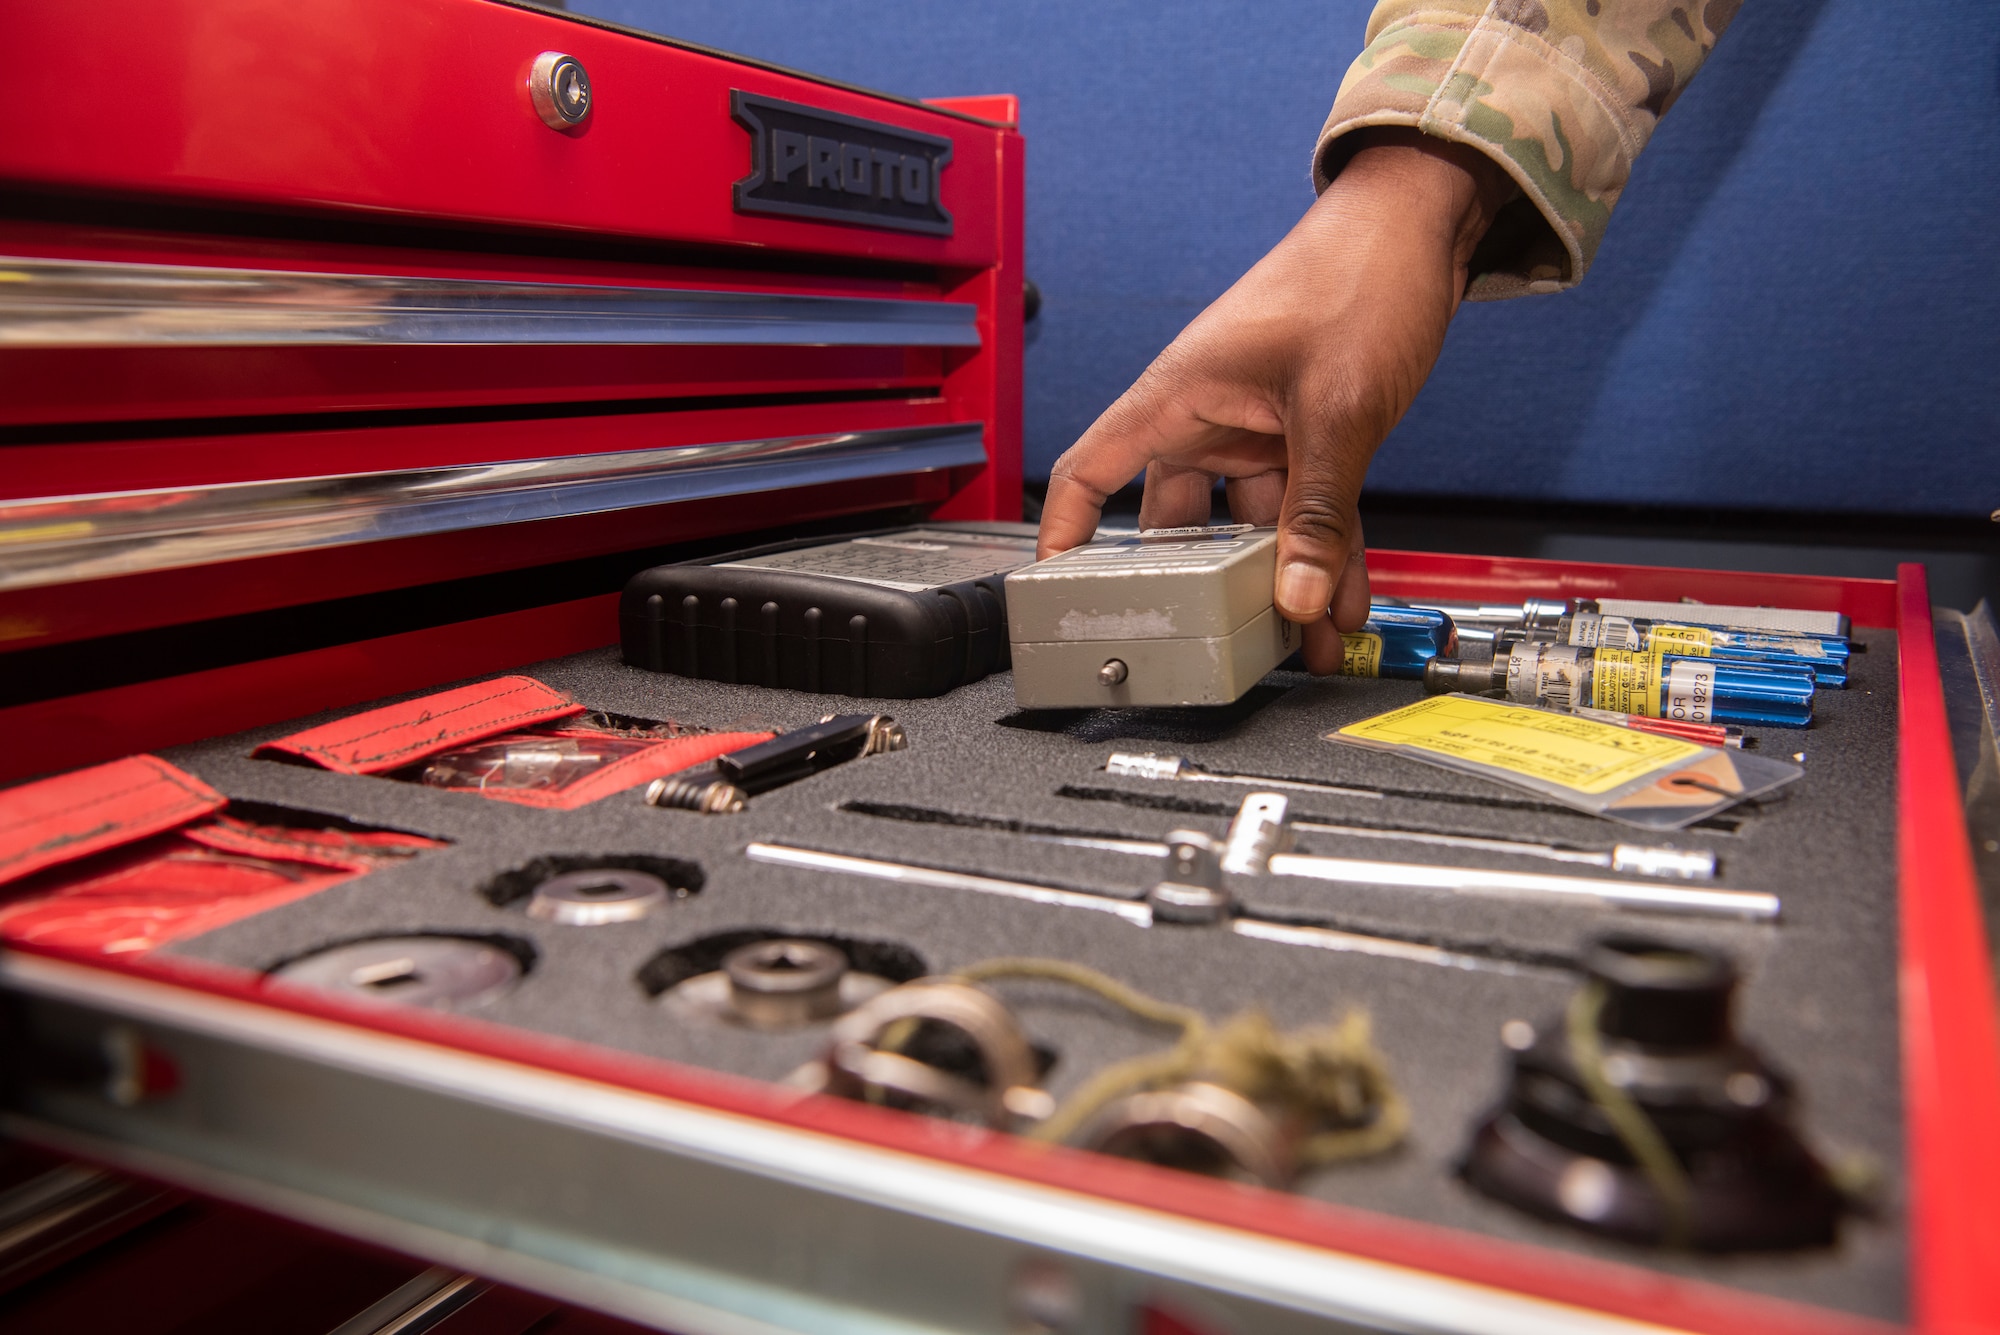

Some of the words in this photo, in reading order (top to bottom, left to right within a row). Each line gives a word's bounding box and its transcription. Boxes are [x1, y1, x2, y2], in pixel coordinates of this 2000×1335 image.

[773, 128, 929, 205] PROTO
[1541, 671, 1549, 690] TMDE
[1622, 690, 1630, 702] only
[1692, 673, 1708, 722] 019273
